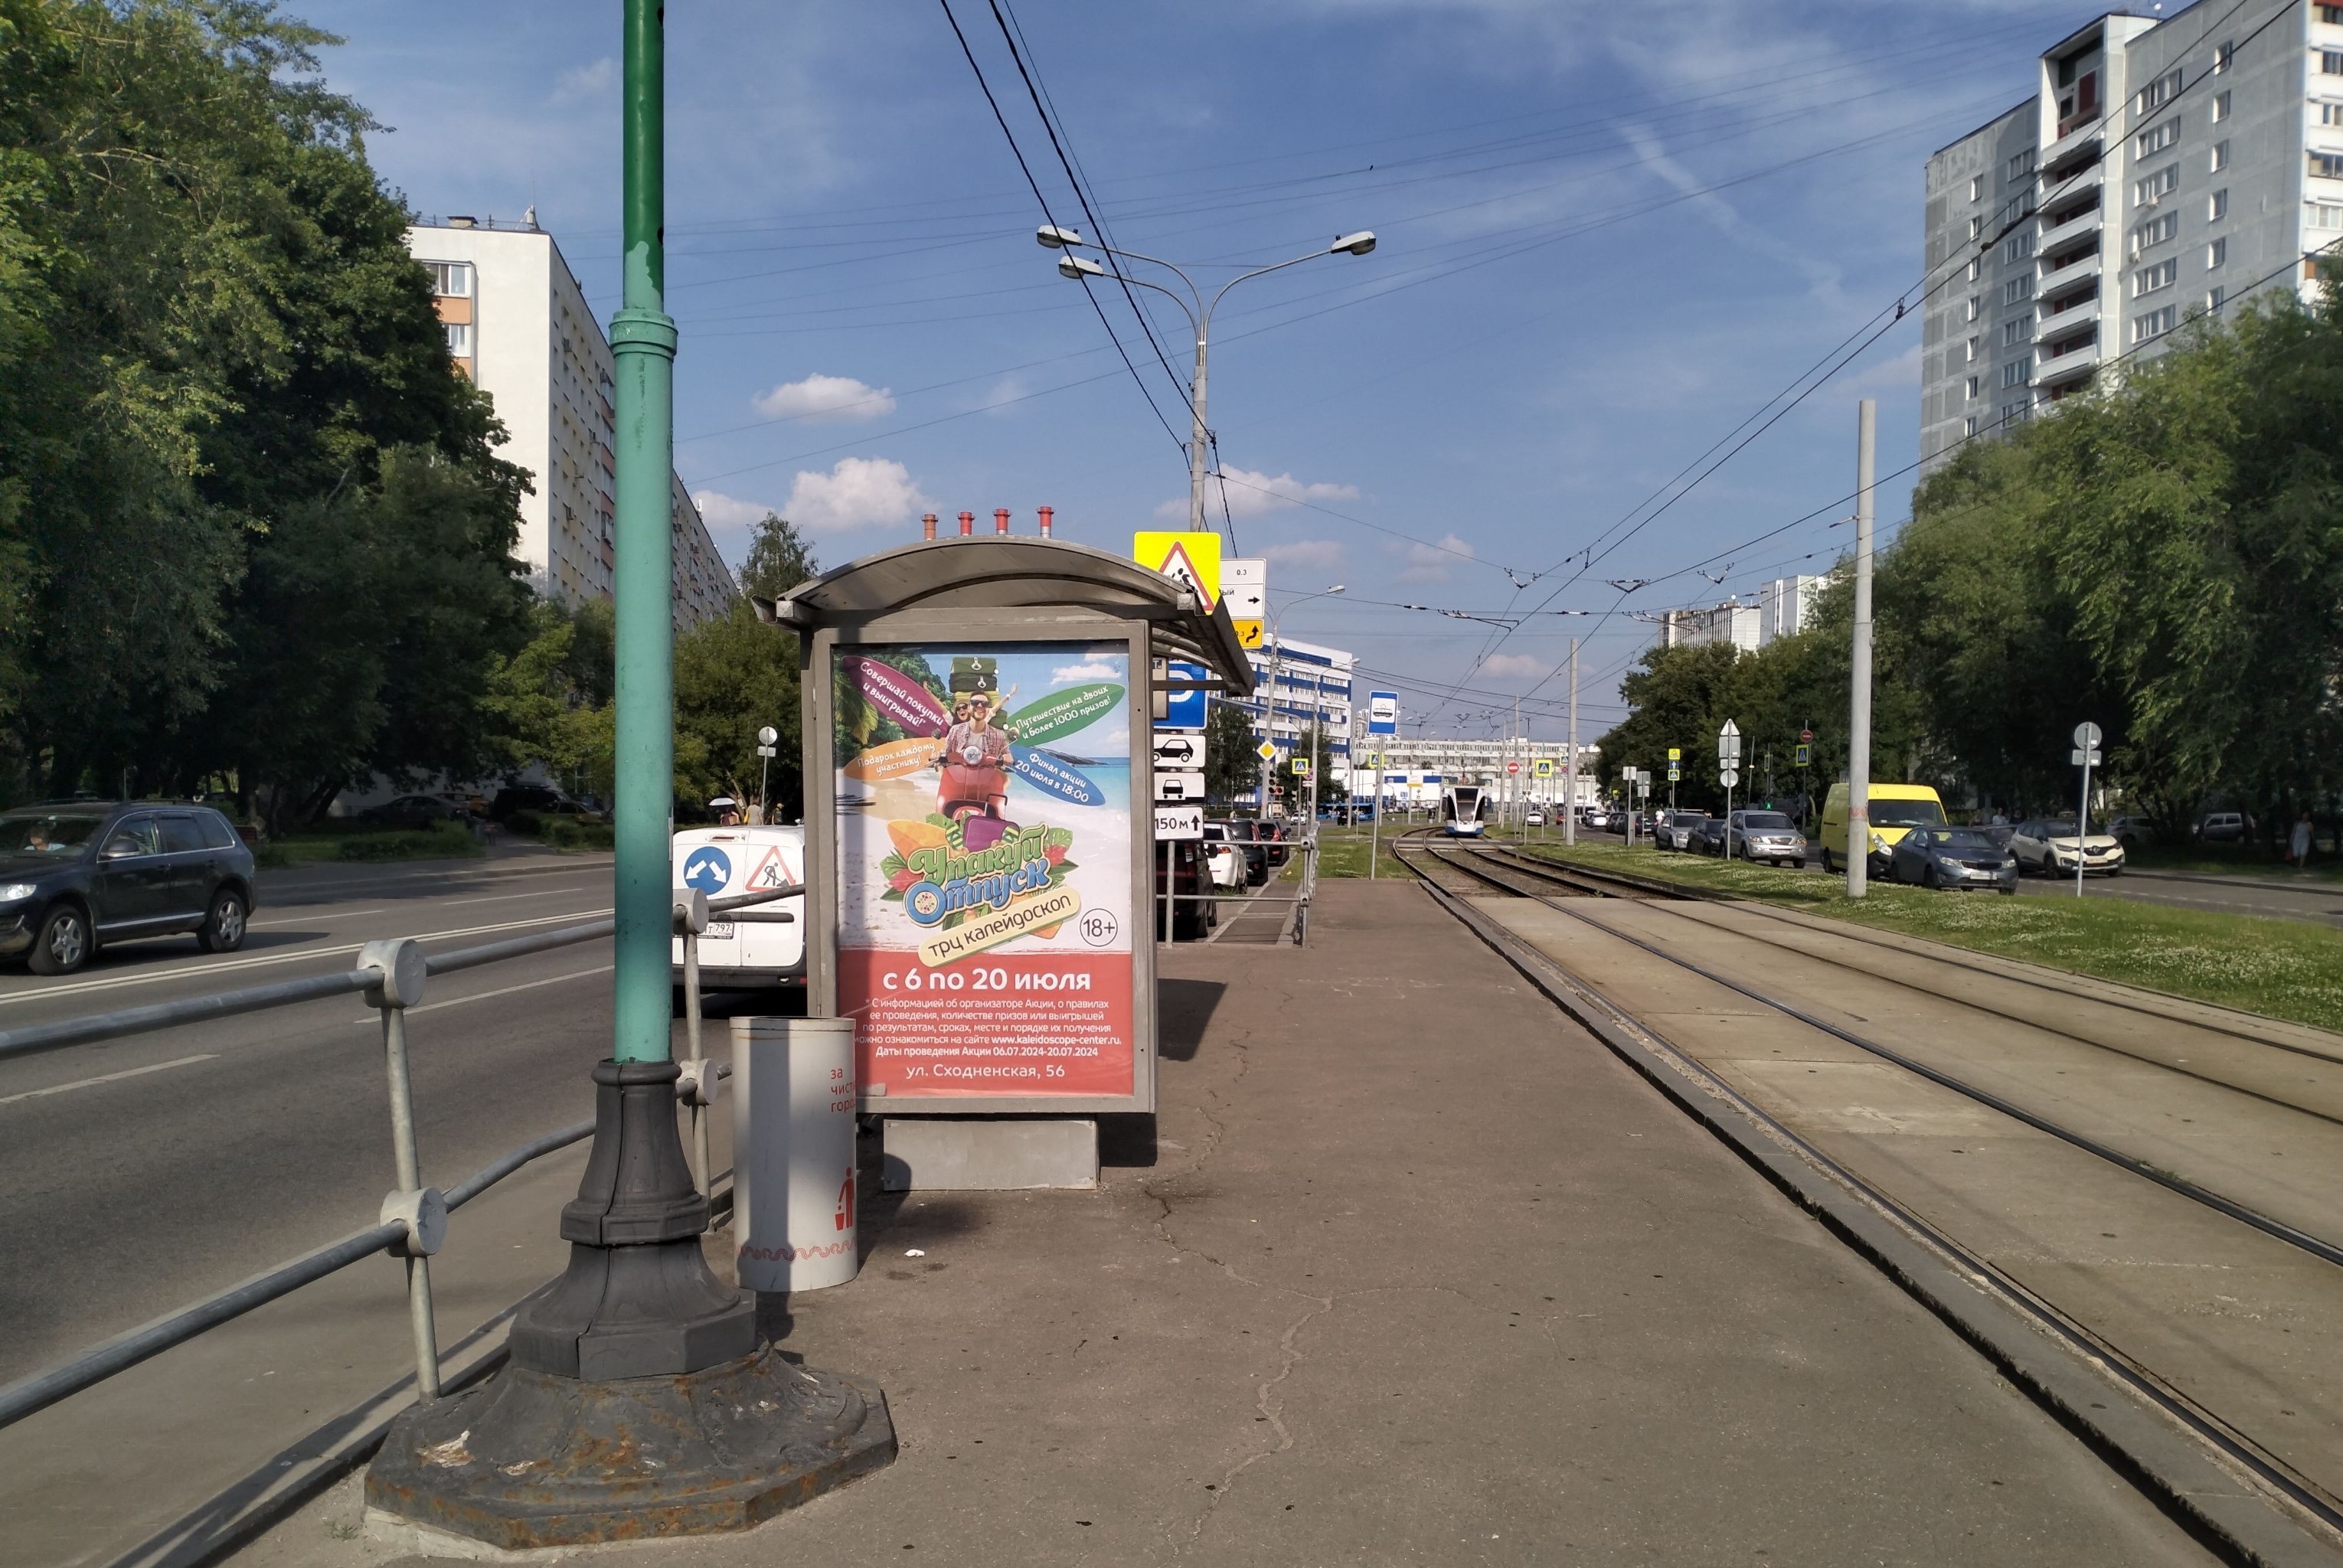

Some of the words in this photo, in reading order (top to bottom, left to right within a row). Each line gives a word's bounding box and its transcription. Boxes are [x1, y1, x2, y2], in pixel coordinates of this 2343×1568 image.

[860, 662, 907, 700] Совершай
[906, 695, 944, 726] покупки
[862, 682, 871, 691] и
[1015, 701, 1071, 730] Путешествие
[1071, 696, 1083, 706] на
[1083, 685, 1109, 701] двоих
[1028, 724, 1054, 737] более
[1053, 710, 1079, 726] 1000
[1080, 695, 1112, 717] призов!
[857, 752, 895, 768] Подарок
[896, 743, 936, 757] каждому
[876, 755, 922, 776] участнику!
[1029, 753, 1059, 775] Финал
[1059, 769, 1087, 789] акции
[1015, 760, 1030, 773] 20
[1030, 769, 1054, 786] июля
[1054, 781, 1060, 789] в
[1062, 783, 1090, 803] 18:00
[1155, 817, 1178, 830] 150
[909, 823, 1047, 884] Упакуй
[905, 858, 1050, 925] Отпуск
[715, 923, 730, 933] 797
[963, 894, 1072, 943] калейдоскоп
[1083, 918, 1116, 937] 18+
[883, 972, 898, 990] с
[904, 968, 922, 991] 6
[930, 972, 965, 990] по
[972, 968, 1008, 991] 20
[1015, 972, 1091, 991] июля
[881, 998, 944, 1010] информацией
[946, 998, 958, 1008] об
[959, 1000, 1023, 1010] организаторе
[1024, 998, 1056, 1010] Акции,
[1057, 1000, 1064, 1008] о
[1066, 1000, 1109, 1010] правилах
[870, 1011, 881, 1020] ее
[882, 1011, 939, 1021] проведения,
[941, 1011, 993, 1021] количестве
[995, 1012, 1028, 1022] призов
[1030, 1012, 1047, 1021] или
[1048, 1011, 1104, 1022] выигрышей
[876, 1024, 937, 1034] результатам,
[939, 1024, 972, 1034] сроках,
[973, 1024, 1001, 1032] месте
[1010, 1024, 1049, 1034] порядке
[1063, 1024, 1111, 1034] получения
[884, 1036, 949, 1044] ознакомиться
[950, 1036, 962, 1044] на
[963, 1035, 990, 1044] сайте
[875, 1046, 902, 1058] Даты
[904, 1047, 960, 1058] проведения
[961, 1046, 992, 1058] Акции
[992, 1047, 1099, 1057] 06.07.2024-20.07.2024
[830, 1068, 843, 1080] за
[906, 1066, 929, 1080] ул.
[933, 1063, 1041, 1080] Сходненская,
[1046, 1064, 1066, 1078] 56
[831, 1082, 855, 1095] чист
